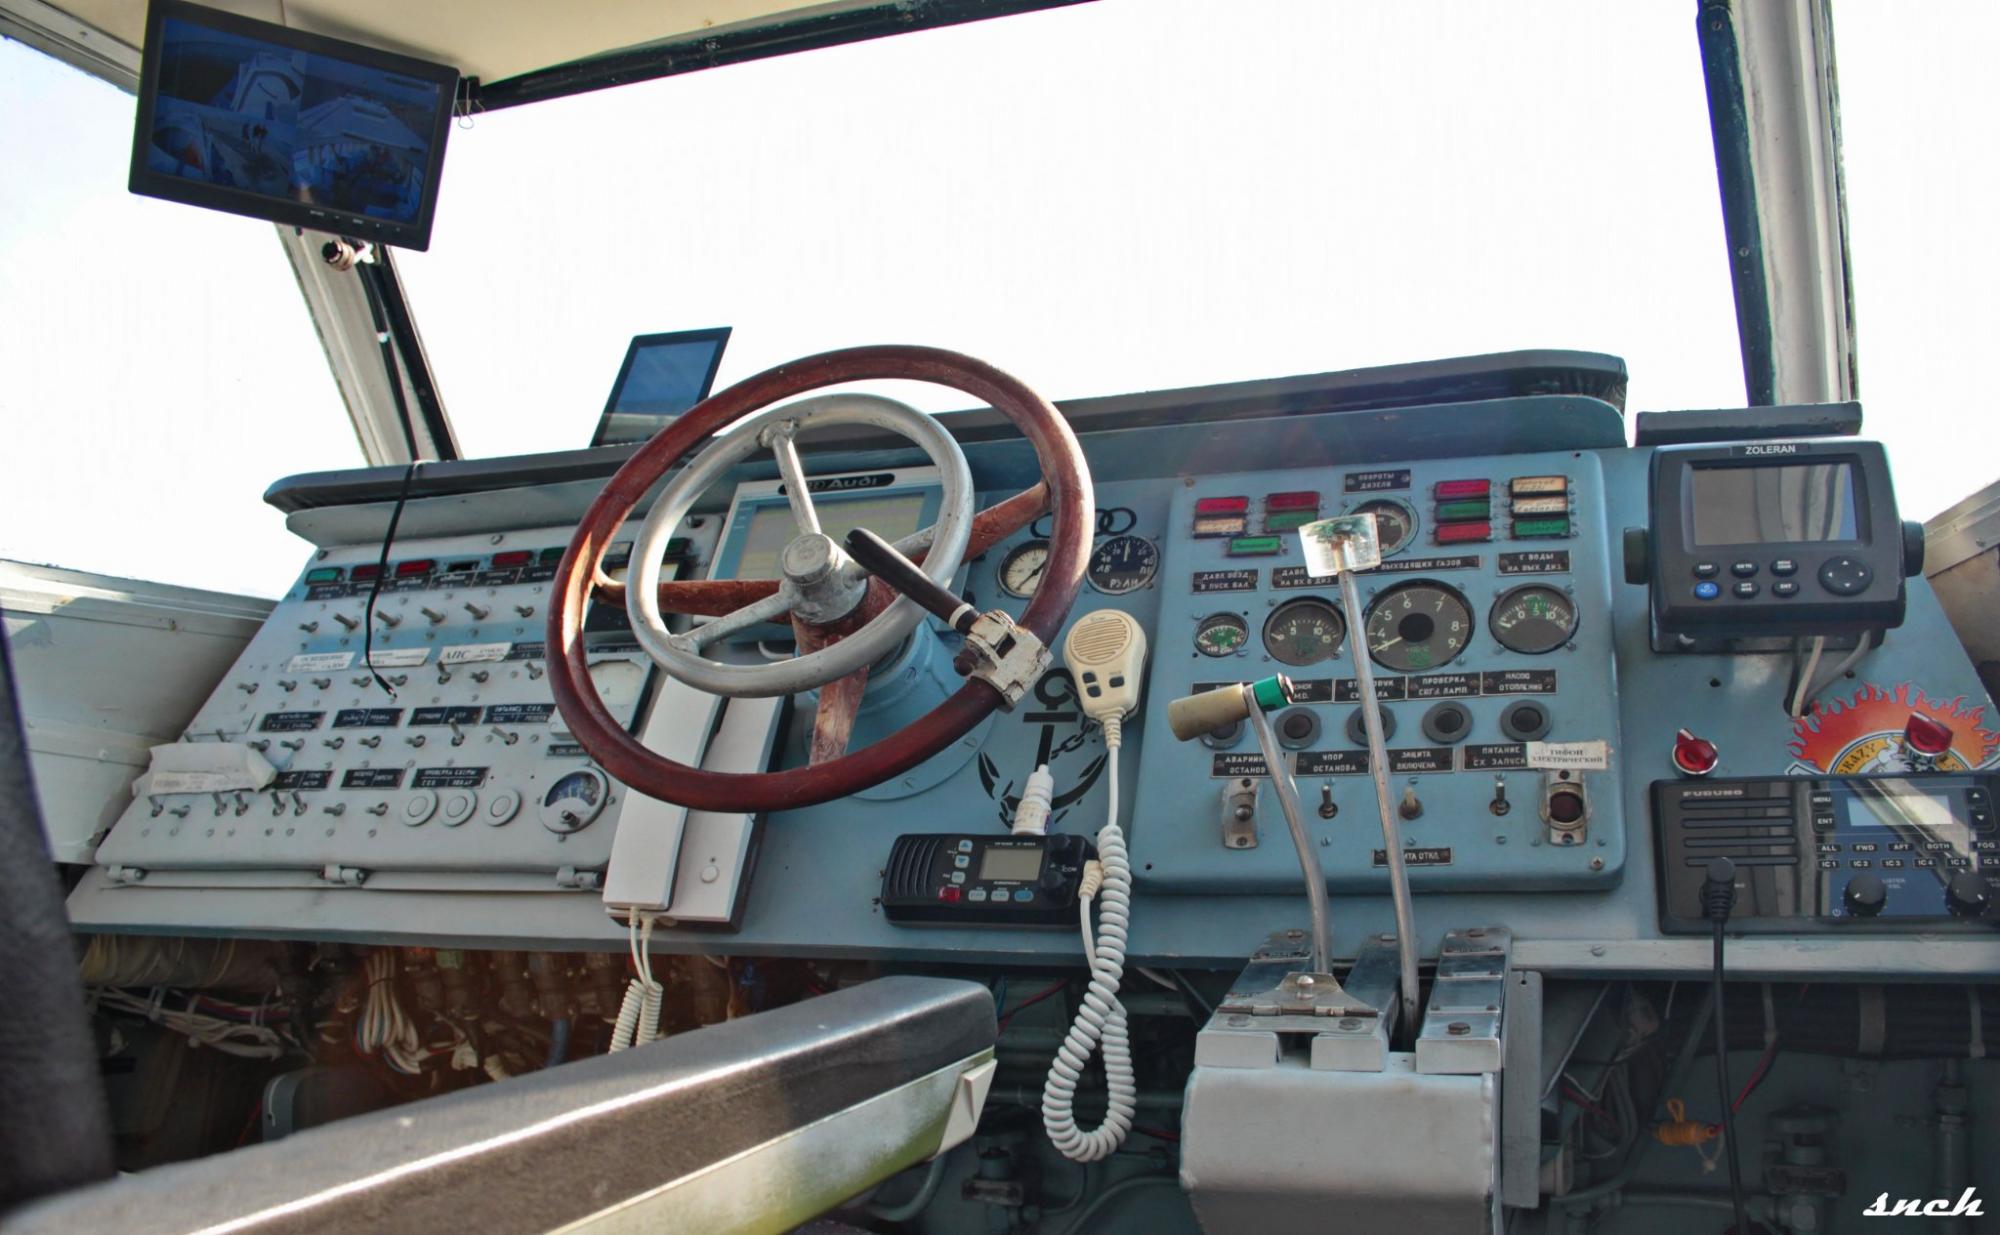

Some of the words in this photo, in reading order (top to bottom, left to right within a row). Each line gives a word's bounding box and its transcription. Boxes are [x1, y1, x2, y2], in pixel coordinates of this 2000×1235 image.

[1745, 445, 1796, 455] ZOLERAN
[1403, 598, 1412, 609] 6
[1435, 601, 1443, 612] 7
[1384, 610, 1392, 621] 5
[1518, 610, 1525, 619] 0
[1545, 611, 1557, 620] 10
[1290, 626, 1296, 636] 5
[1313, 626, 1323, 636] 10
[1451, 621, 1460, 632] 8
[1377, 628, 1386, 638] 4
[1448, 638, 1457, 649] 9
[1422, 676, 1466, 685] ПРОВЕРКА
[1443, 686, 1467, 695] ЛАМП
[1401, 750, 1431, 759] ЗАЩИТА
[1482, 746, 1520, 755] ПИТАНИЕ
[1313, 764, 1357, 773] ОСТАНОВА
[1397, 761, 1436, 770] ВКЛЮЧЕНА
[1682, 788, 1744, 798] FURUNO
[1817, 817, 1833, 825] ENT
[1893, 843, 1909, 851] AFT
[1927, 842, 1950, 850] BOTH
